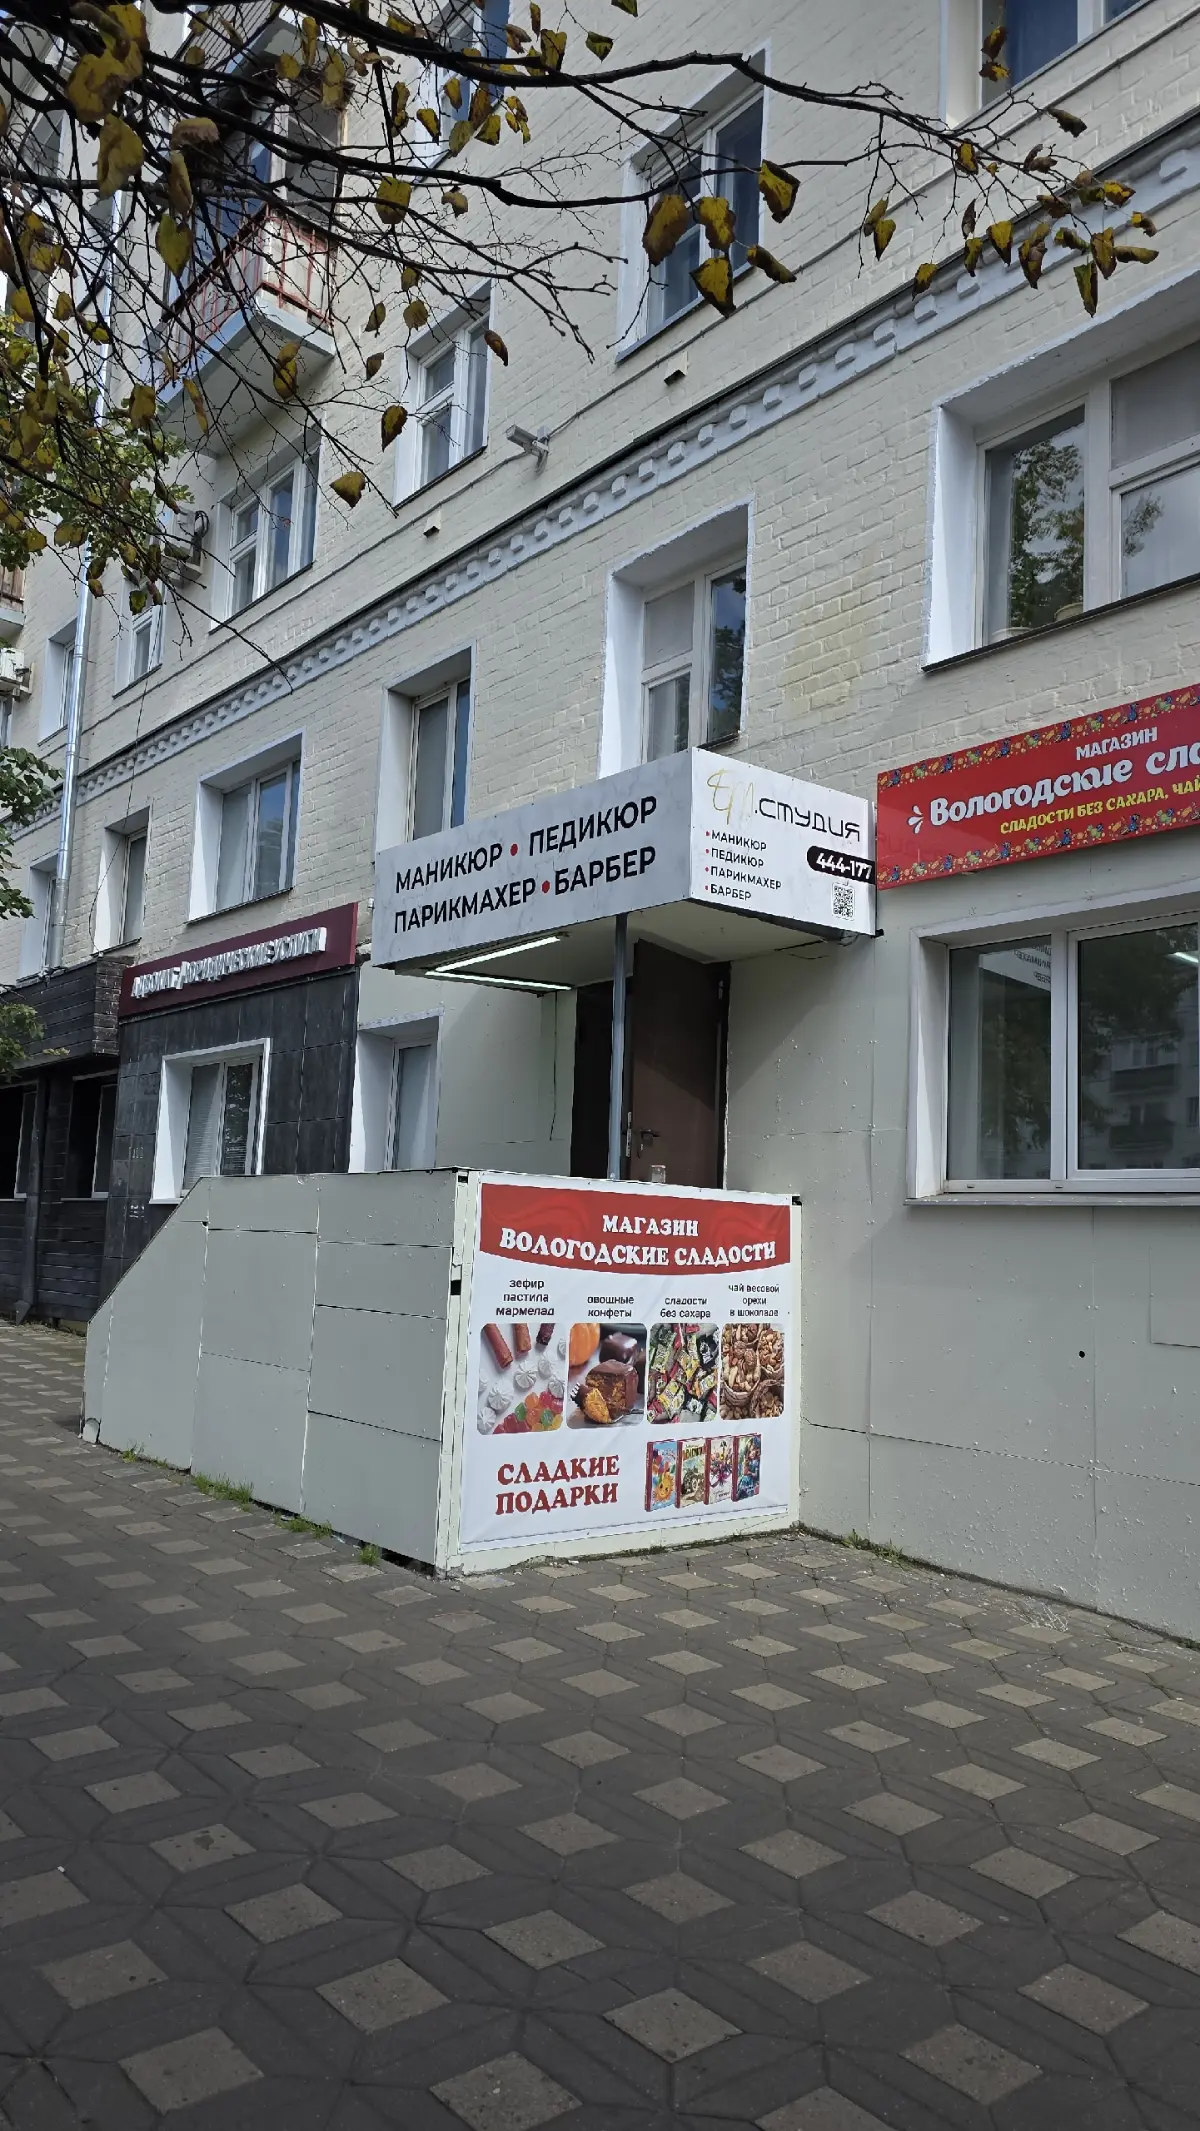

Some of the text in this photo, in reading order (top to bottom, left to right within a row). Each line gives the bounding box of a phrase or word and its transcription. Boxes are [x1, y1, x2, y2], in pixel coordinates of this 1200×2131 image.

[1076, 727, 1157, 760] МАГАЗИН
[930, 760, 1133, 825] Вологодские
[1000, 807, 1074, 835] СЛАДОСТИ
[1077, 801, 1103, 817] БЕЗ
[1106, 786, 1169, 811] САХАРА,
[395, 795, 657, 893] МАНИКЮР ПЕДИКЮР
[711, 829, 767, 851] МАНИКЮР
[711, 847, 764, 868] ПЕДИКЮР
[816, 852, 872, 880] 444-177
[710, 866, 782, 890] ПАРИКМАХЕР
[394, 846, 656, 933] ПАРИКМАХЕР БАРБЕР
[710, 883, 752, 901] БАРБЕР
[602, 1214, 699, 1237] МАГАЗИН
[499, 1227, 777, 1267] ВОЛОГОДСКИЕ СЛАДОСТИ
[509, 1278, 545, 1290] зефир
[728, 1283, 780, 1293] чай весовой
[503, 1293, 549, 1303] пастила
[664, 1296, 708, 1306] сладости
[742, 1296, 767, 1306] орехи
[495, 1307, 555, 1317] мармелад
[588, 1308, 632, 1319] конфеты
[659, 1308, 711, 1320] без сахара
[729, 1309, 779, 1317] в шоколаде
[497, 1455, 619, 1485] СЛАДКИЕ
[495, 1482, 619, 1516] ПОДАРКИ
